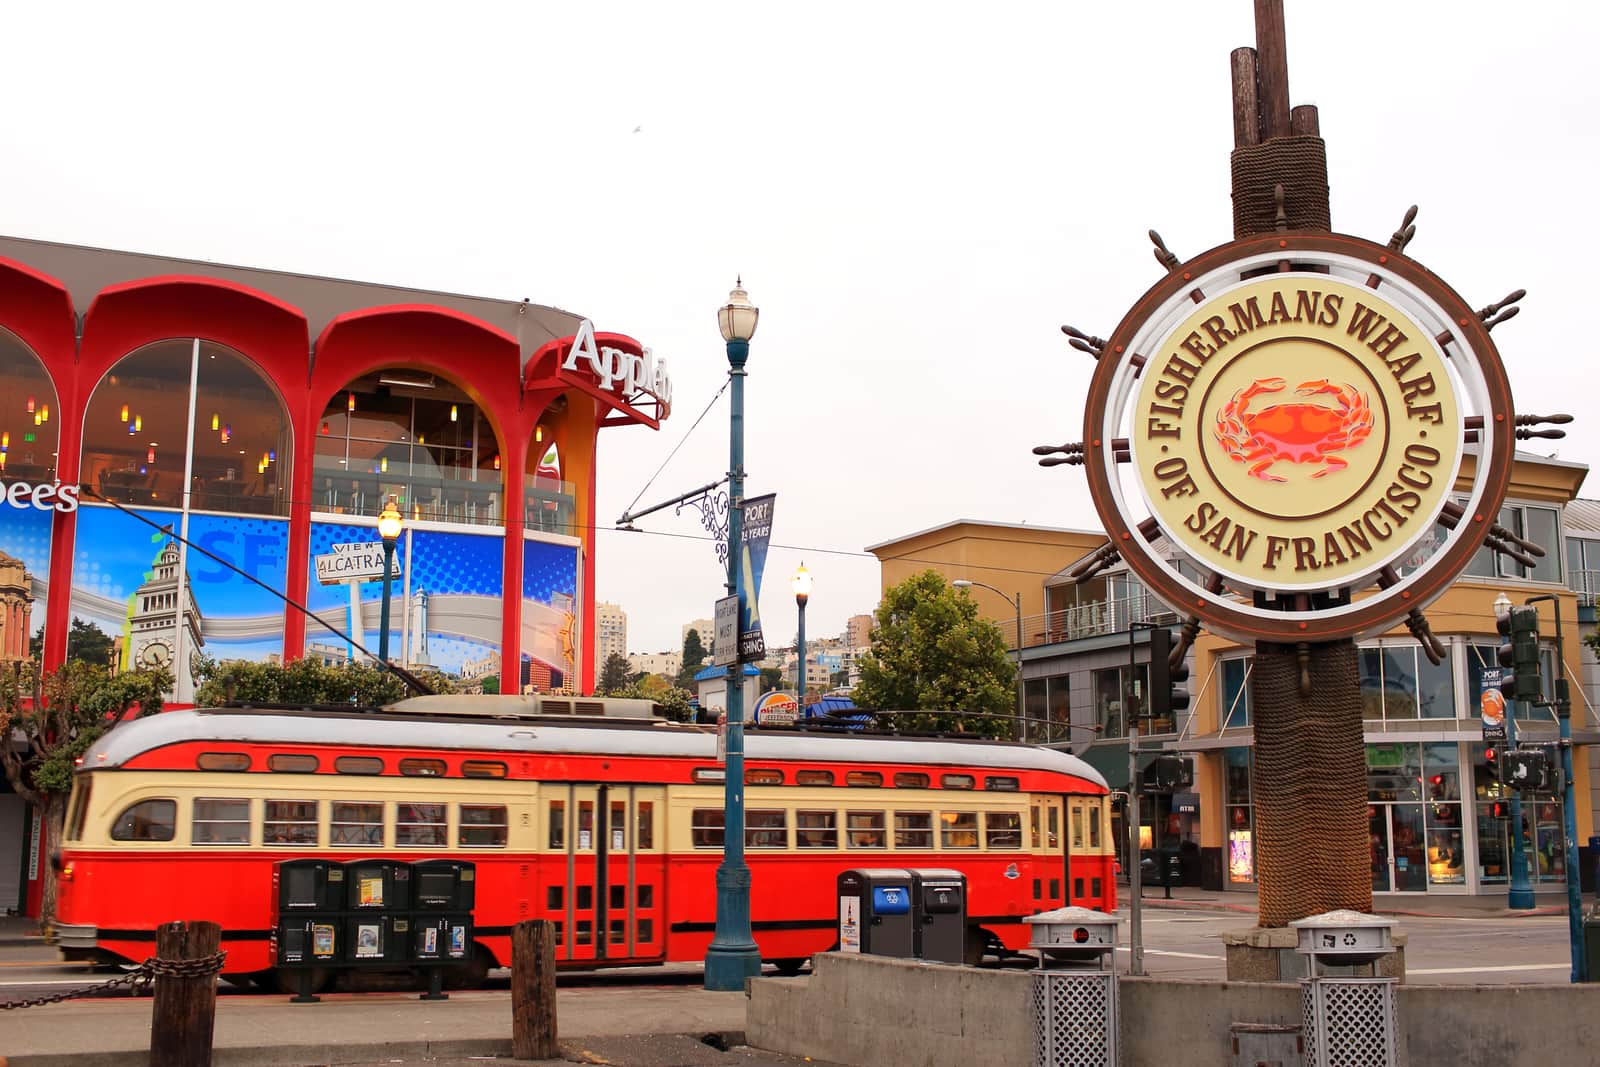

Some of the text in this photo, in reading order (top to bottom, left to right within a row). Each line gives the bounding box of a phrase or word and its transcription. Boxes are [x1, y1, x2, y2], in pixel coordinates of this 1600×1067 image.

[1148, 289, 1443, 440] FISHERMANS WHARF
[0, 479, 80, 512] ee's
[1153, 444, 1441, 572] OF SAN FRANCISCO
[744, 504, 769, 522] PORT
[749, 526, 770, 539] YEARS
[197, 530, 281, 584] SF
[334, 542, 374, 553] VIEW
[318, 553, 386, 573] ALCATRA
